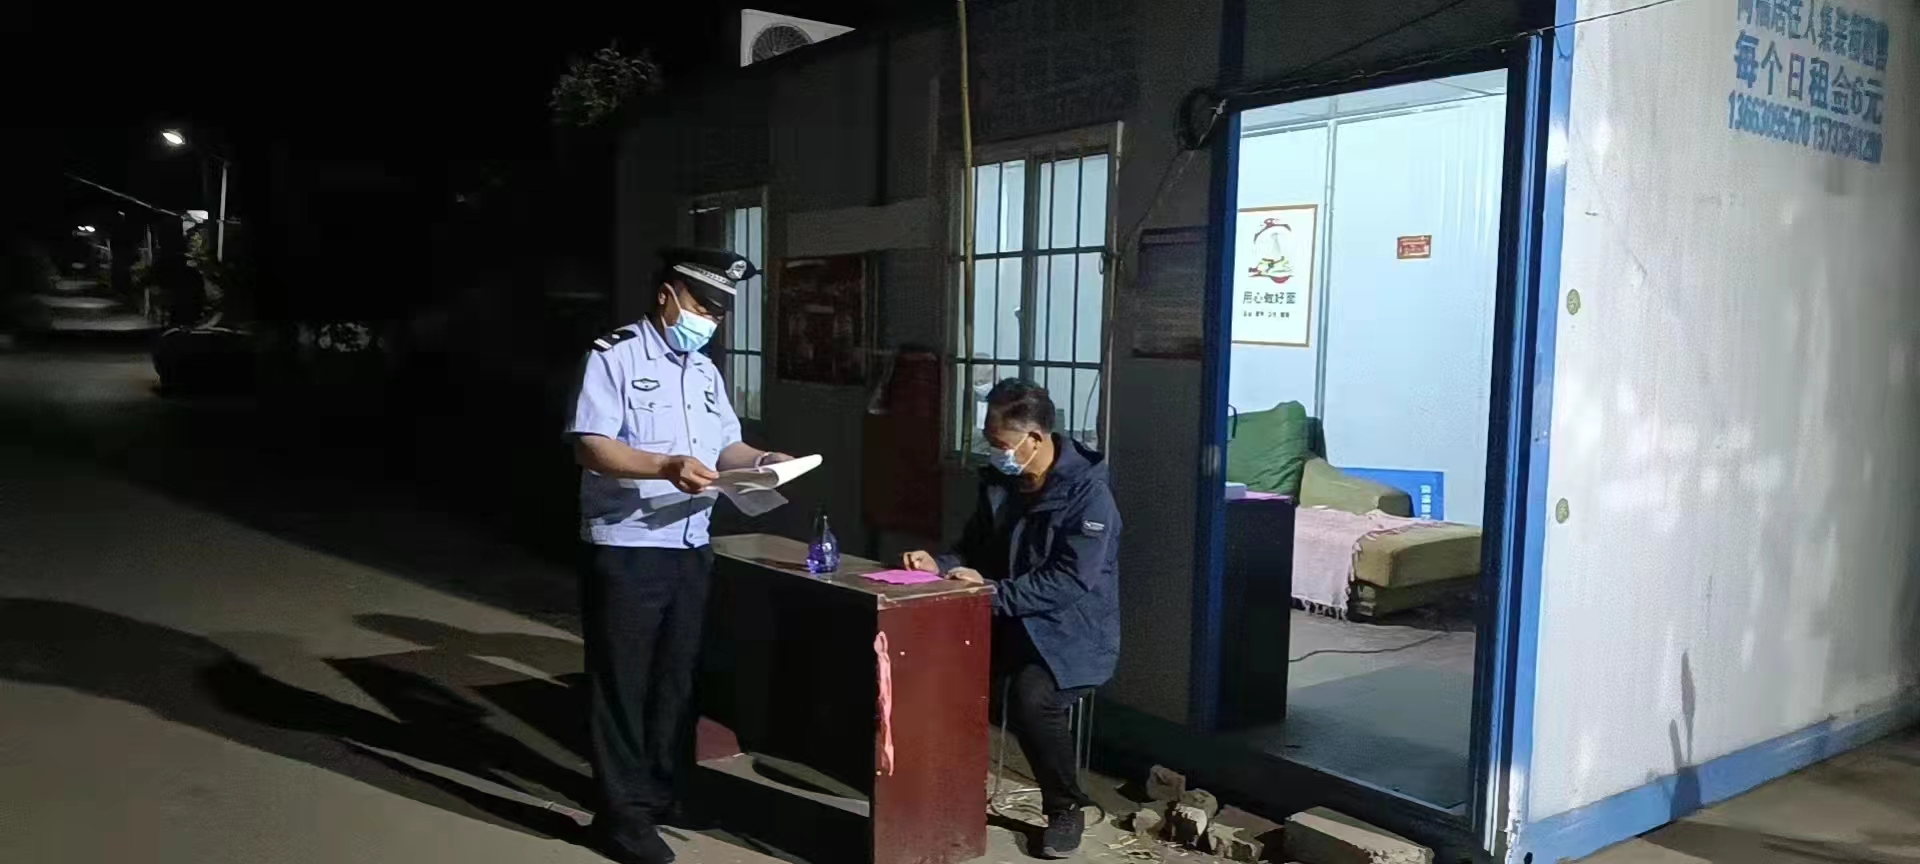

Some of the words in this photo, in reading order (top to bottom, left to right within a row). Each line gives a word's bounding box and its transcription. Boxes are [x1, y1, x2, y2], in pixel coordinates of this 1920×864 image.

[1734, 30, 1885, 125] 每个日租金6元
